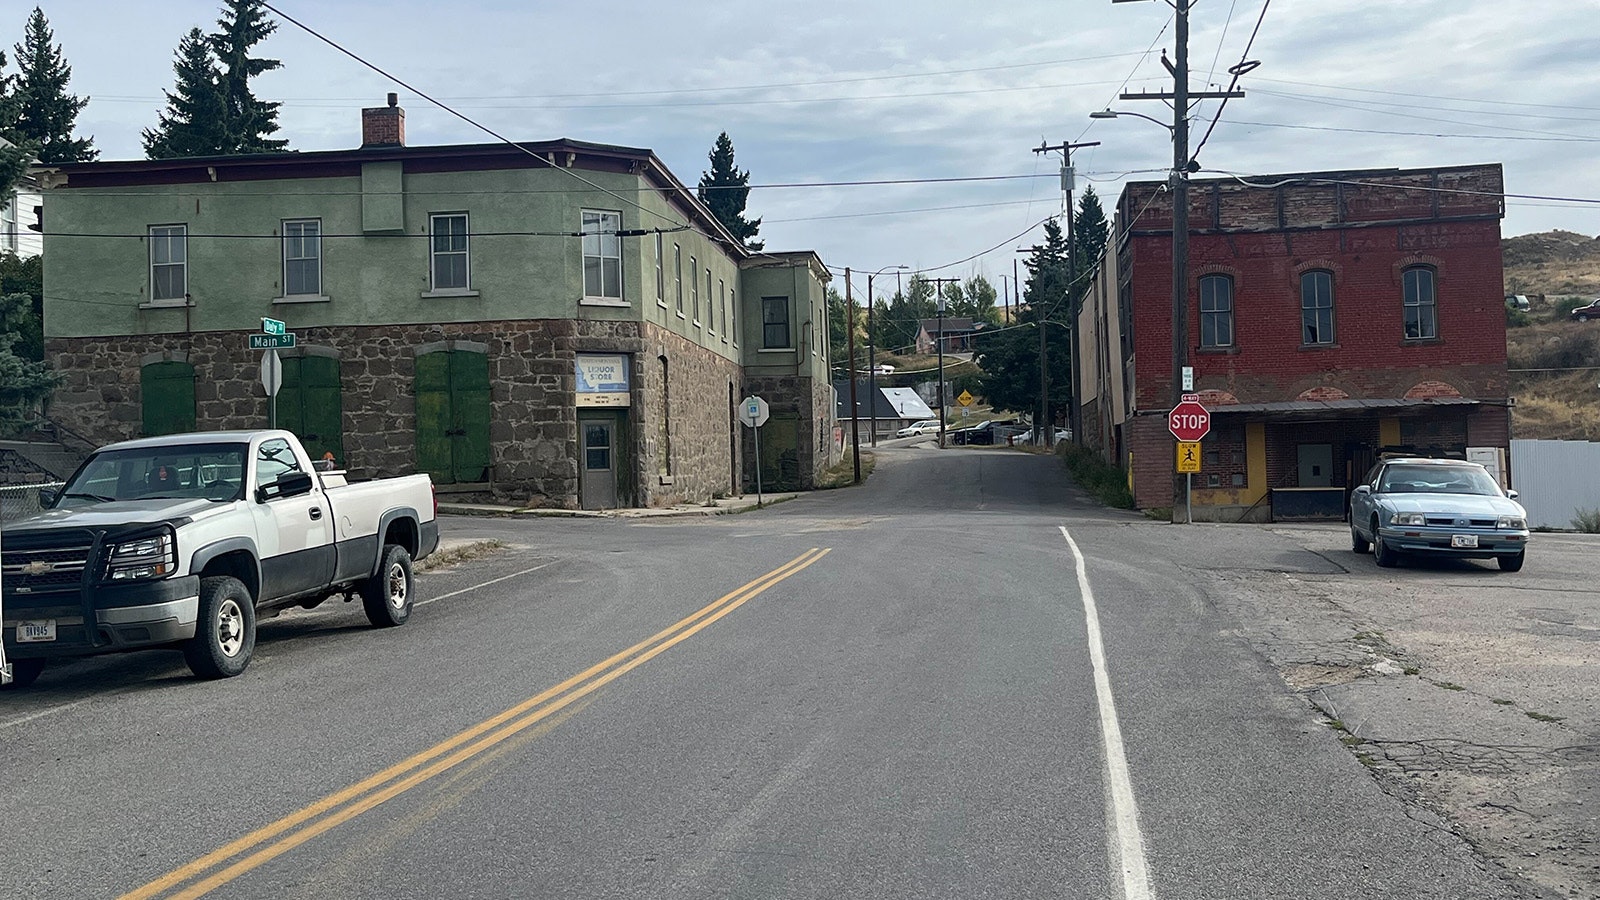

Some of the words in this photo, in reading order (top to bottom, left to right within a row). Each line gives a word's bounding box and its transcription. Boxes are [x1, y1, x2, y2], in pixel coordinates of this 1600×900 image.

[254, 336, 278, 347] Main
[282, 335, 291, 343] ST
[1172, 414, 1207, 429] STOP
